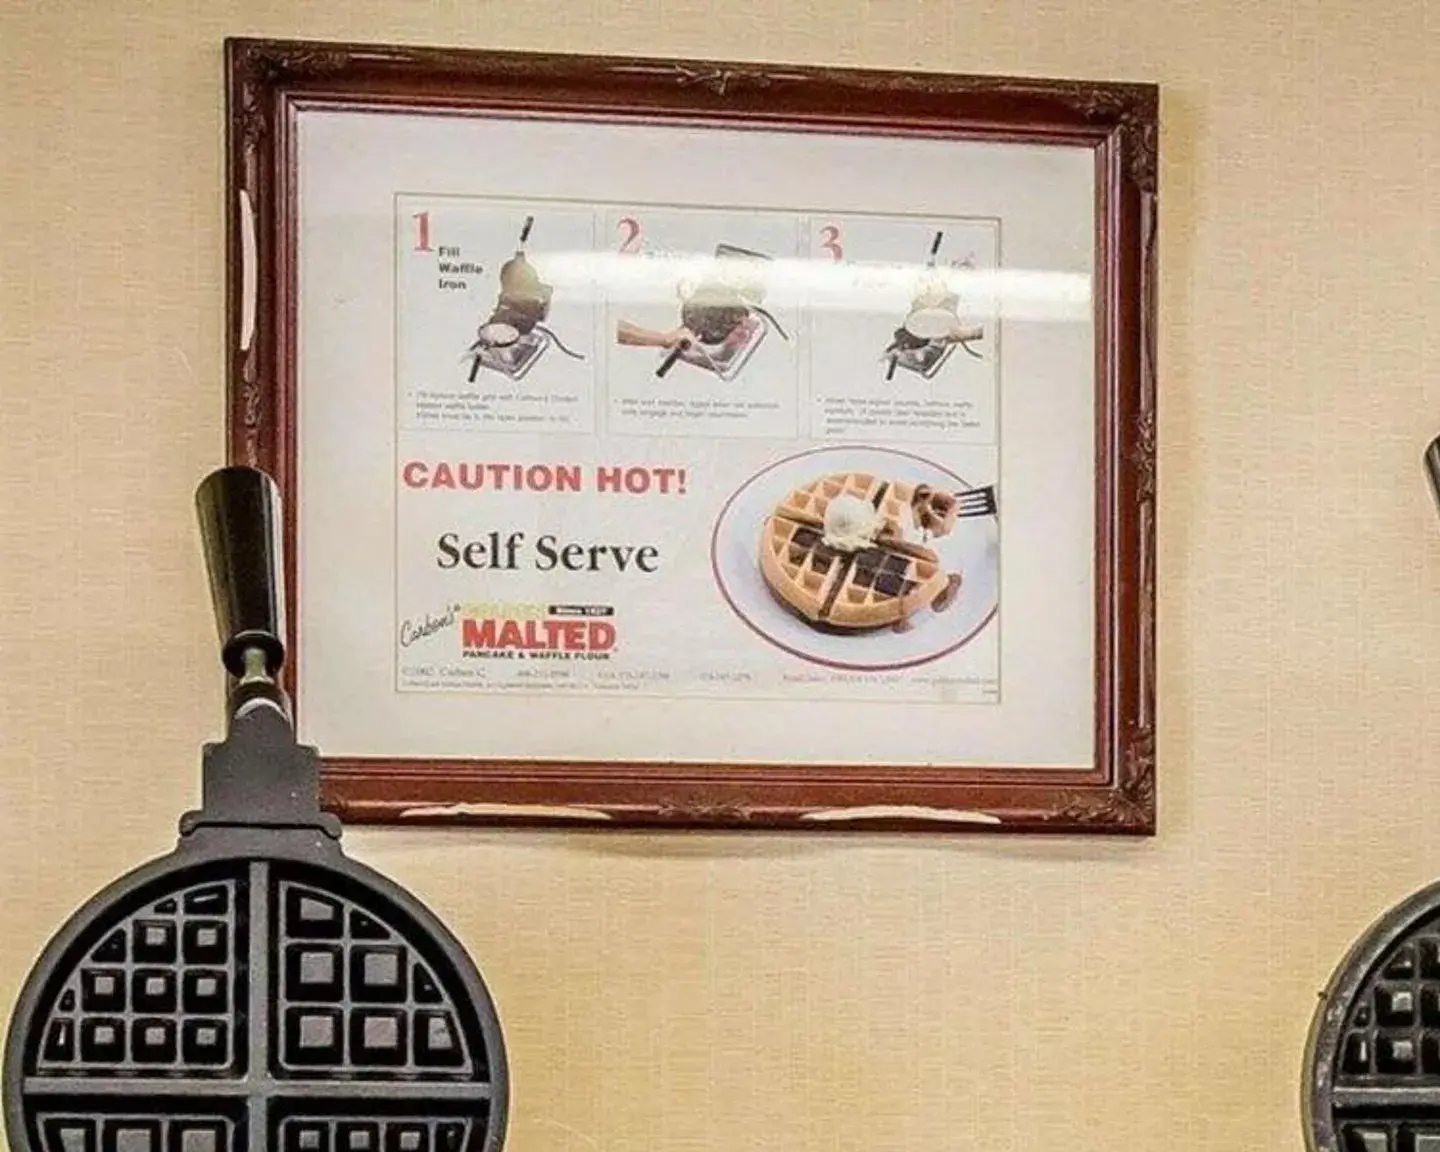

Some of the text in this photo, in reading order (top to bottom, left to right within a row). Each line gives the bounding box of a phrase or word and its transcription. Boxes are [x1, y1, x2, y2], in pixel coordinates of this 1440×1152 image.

[412, 211, 433, 252] 1
[616, 217, 642, 253] 2
[820, 225, 844, 262] 3
[438, 246, 461, 258] Fill
[438, 262, 483, 275] Waffle
[438, 278, 467, 290] Iron
[402, 461, 687, 495] CAUTION HOT!
[436, 531, 660, 573] Self Serve
[462, 618, 618, 652] MALTED
